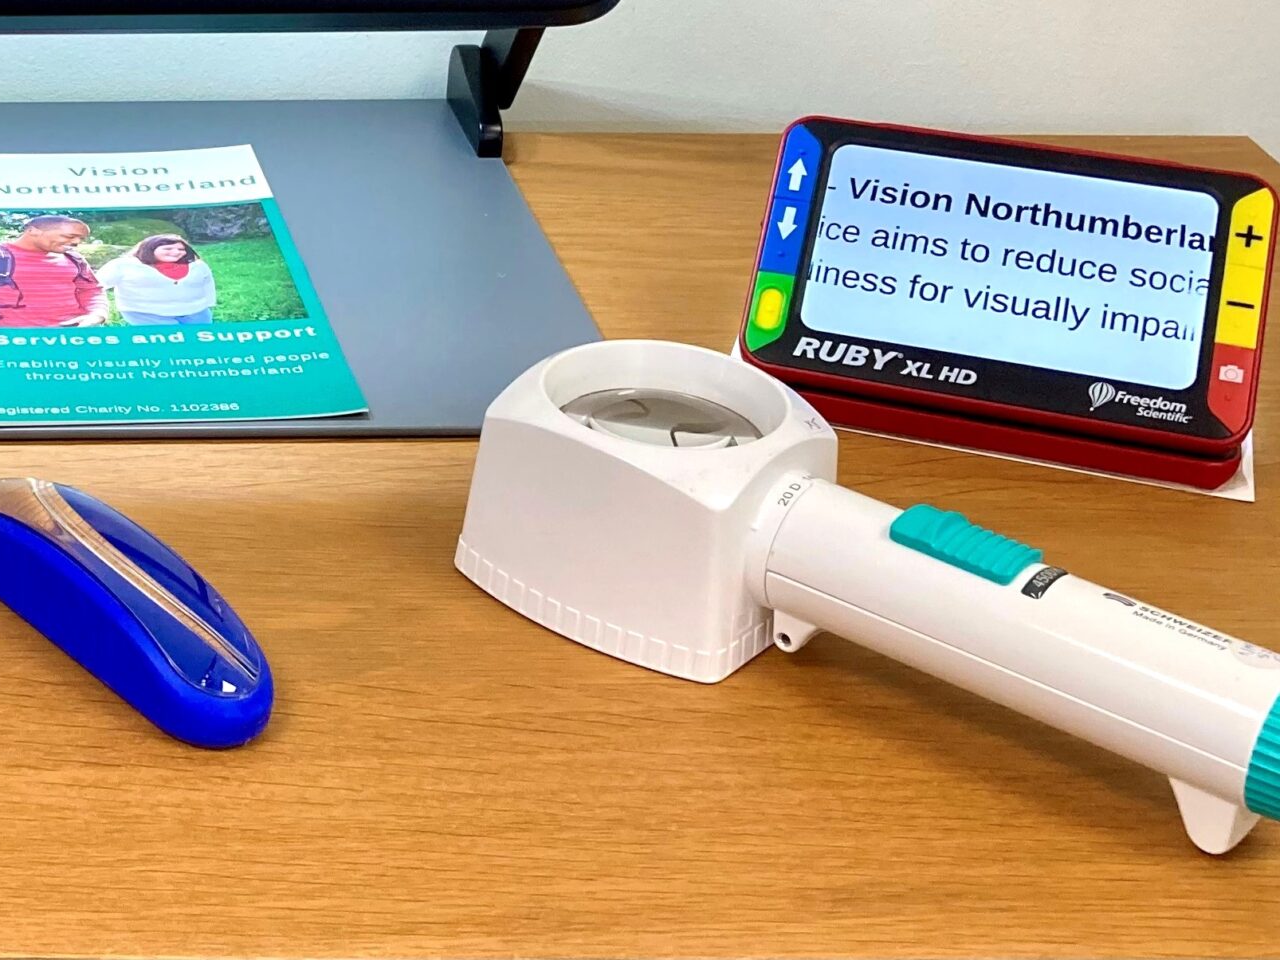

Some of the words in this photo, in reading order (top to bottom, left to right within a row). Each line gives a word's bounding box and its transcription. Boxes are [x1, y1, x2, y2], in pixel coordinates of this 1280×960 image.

[68, 165, 170, 177] Vision
[850, 177, 953, 213] Vision
[871, 226, 949, 257] aims
[960, 238, 991, 263] to
[1001, 247, 1118, 283] reduce
[908, 273, 954, 304] for
[963, 284, 1091, 331] visually
[131, 331, 186, 344] and
[195, 325, 318, 344] Support
[85, 357, 162, 369] visually
[170, 354, 256, 368] impaired
[263, 350, 331, 364] people
[792, 336, 899, 371] RUBY
[900, 359, 934, 379] XL
[938, 365, 978, 386] HD
[25, 370, 135, 383] throughout
[141, 364, 305, 380] Northumberland
[75, 404, 133, 416] Charity
[137, 403, 165, 414] No.
[170, 401, 241, 413] 1102386
[1114, 390, 1188, 414] Freedom
[1136, 406, 1191, 424] Scientific
[1132, 610, 1164, 625] Made
[1177, 628, 1228, 651] Germany
